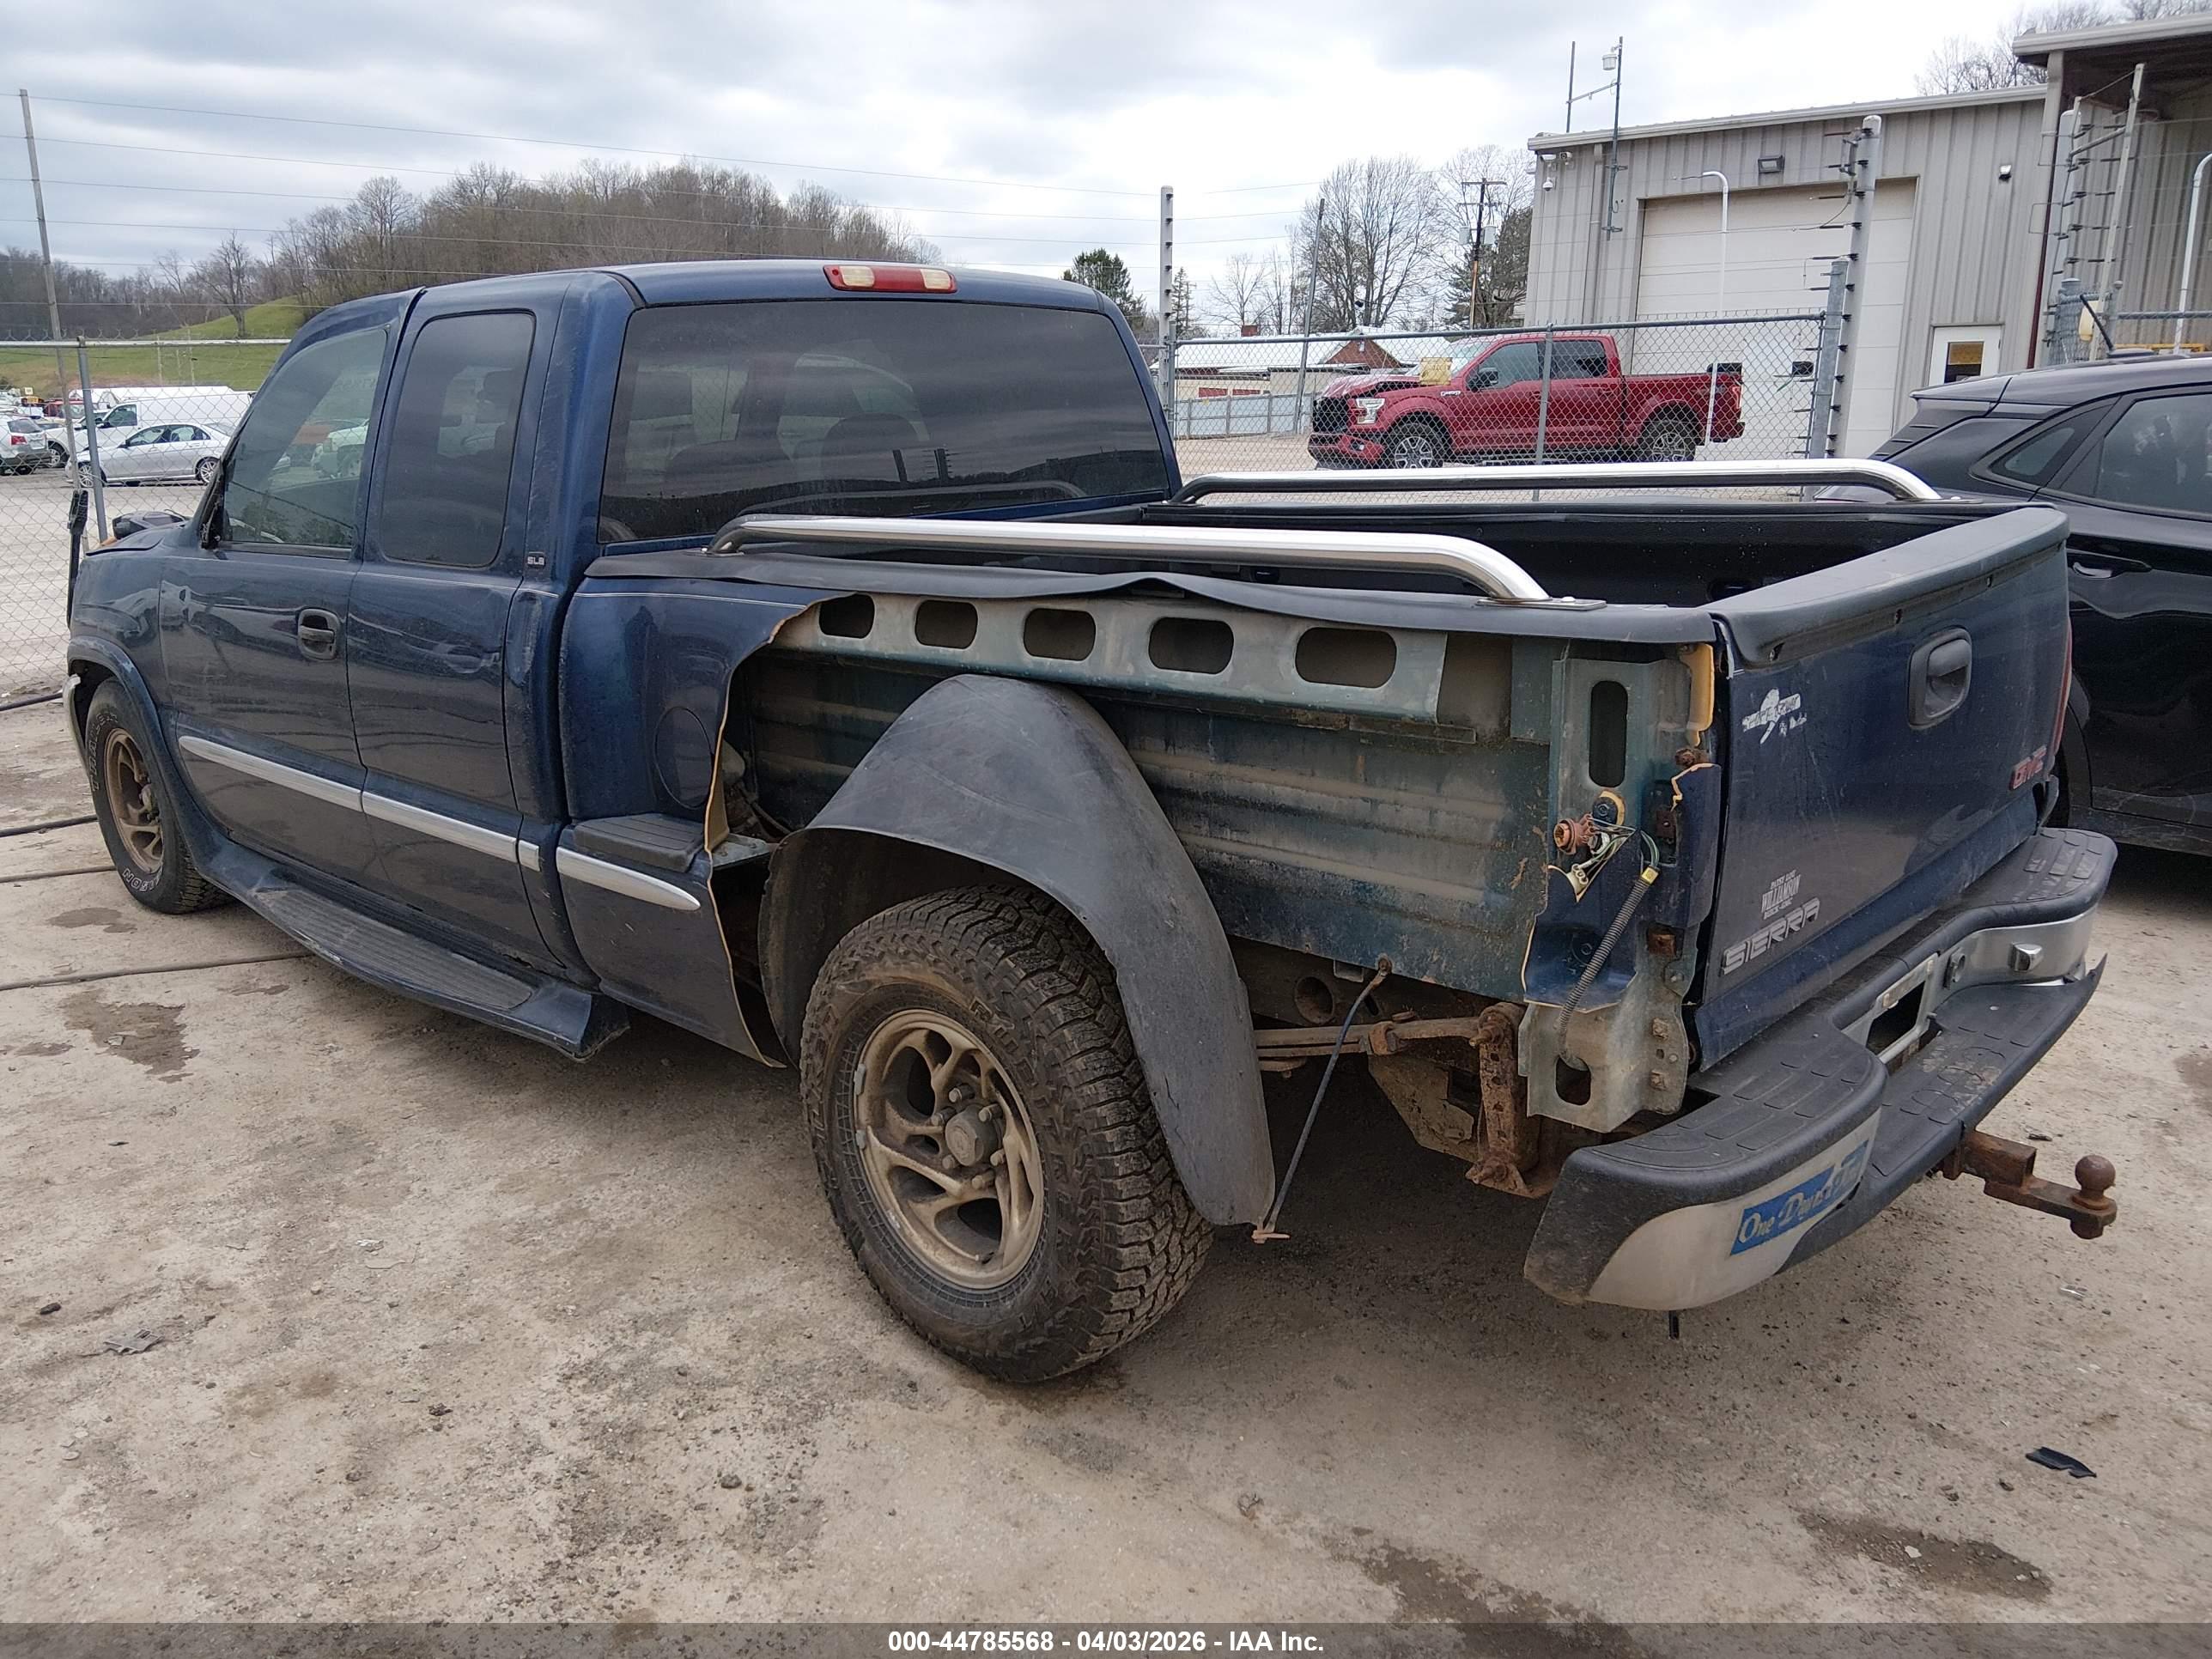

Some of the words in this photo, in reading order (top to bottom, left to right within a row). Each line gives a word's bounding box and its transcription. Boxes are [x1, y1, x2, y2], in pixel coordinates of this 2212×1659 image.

[2010, 745, 2047, 790] GMC
[1721, 896, 1820, 975] SIERRA
[1739, 1212, 1775, 1244] One
